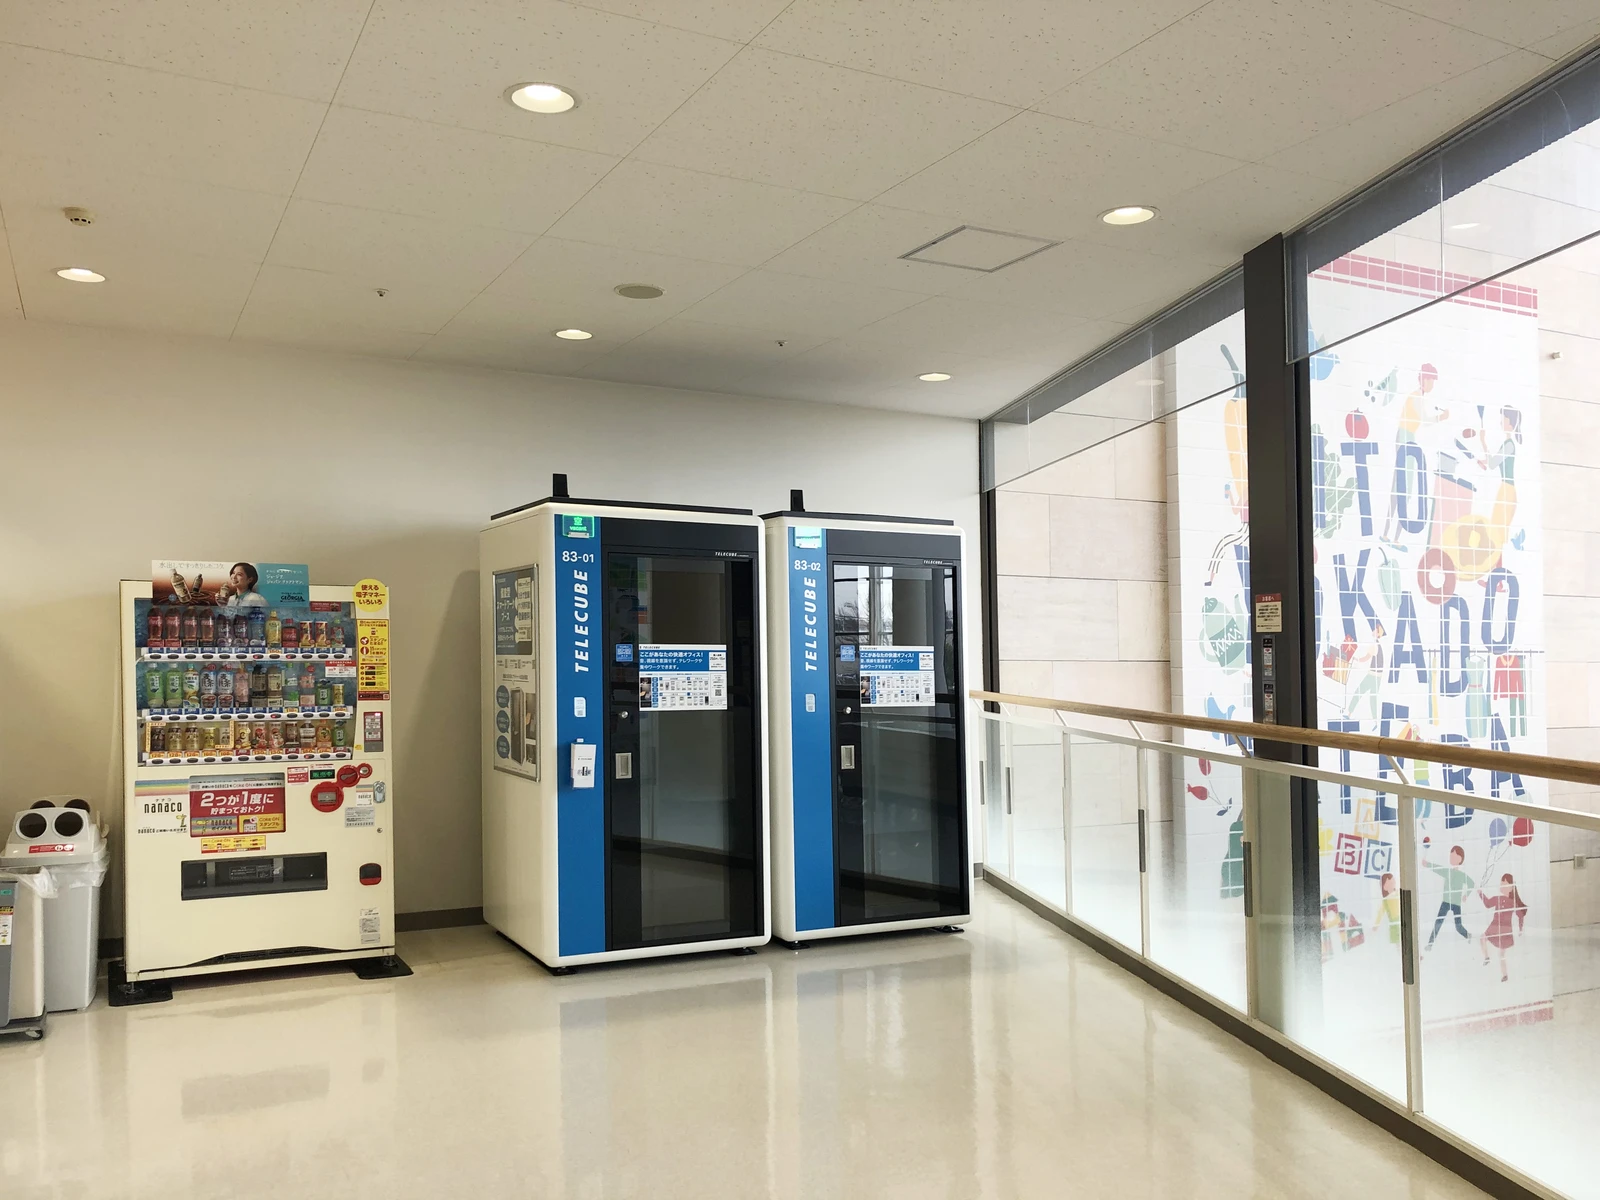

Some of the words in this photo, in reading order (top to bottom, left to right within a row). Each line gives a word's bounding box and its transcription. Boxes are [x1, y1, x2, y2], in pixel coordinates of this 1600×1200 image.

[1312, 435, 1428, 536] ITO
[562, 550, 594, 563] 83-01
[794, 559, 821, 571] 83-02
[355, 591, 386, 599] 電子マネー
[573, 569, 589, 673] TELECUBE
[804, 576, 817, 672] TELECUBE
[200, 791, 275, 807] 2つが1度に
[144, 802, 182, 813] nanaco
[210, 805, 264, 815] 貯まっておトク!
[1341, 842, 1355, 866] B
[1372, 849, 1386, 871] C
